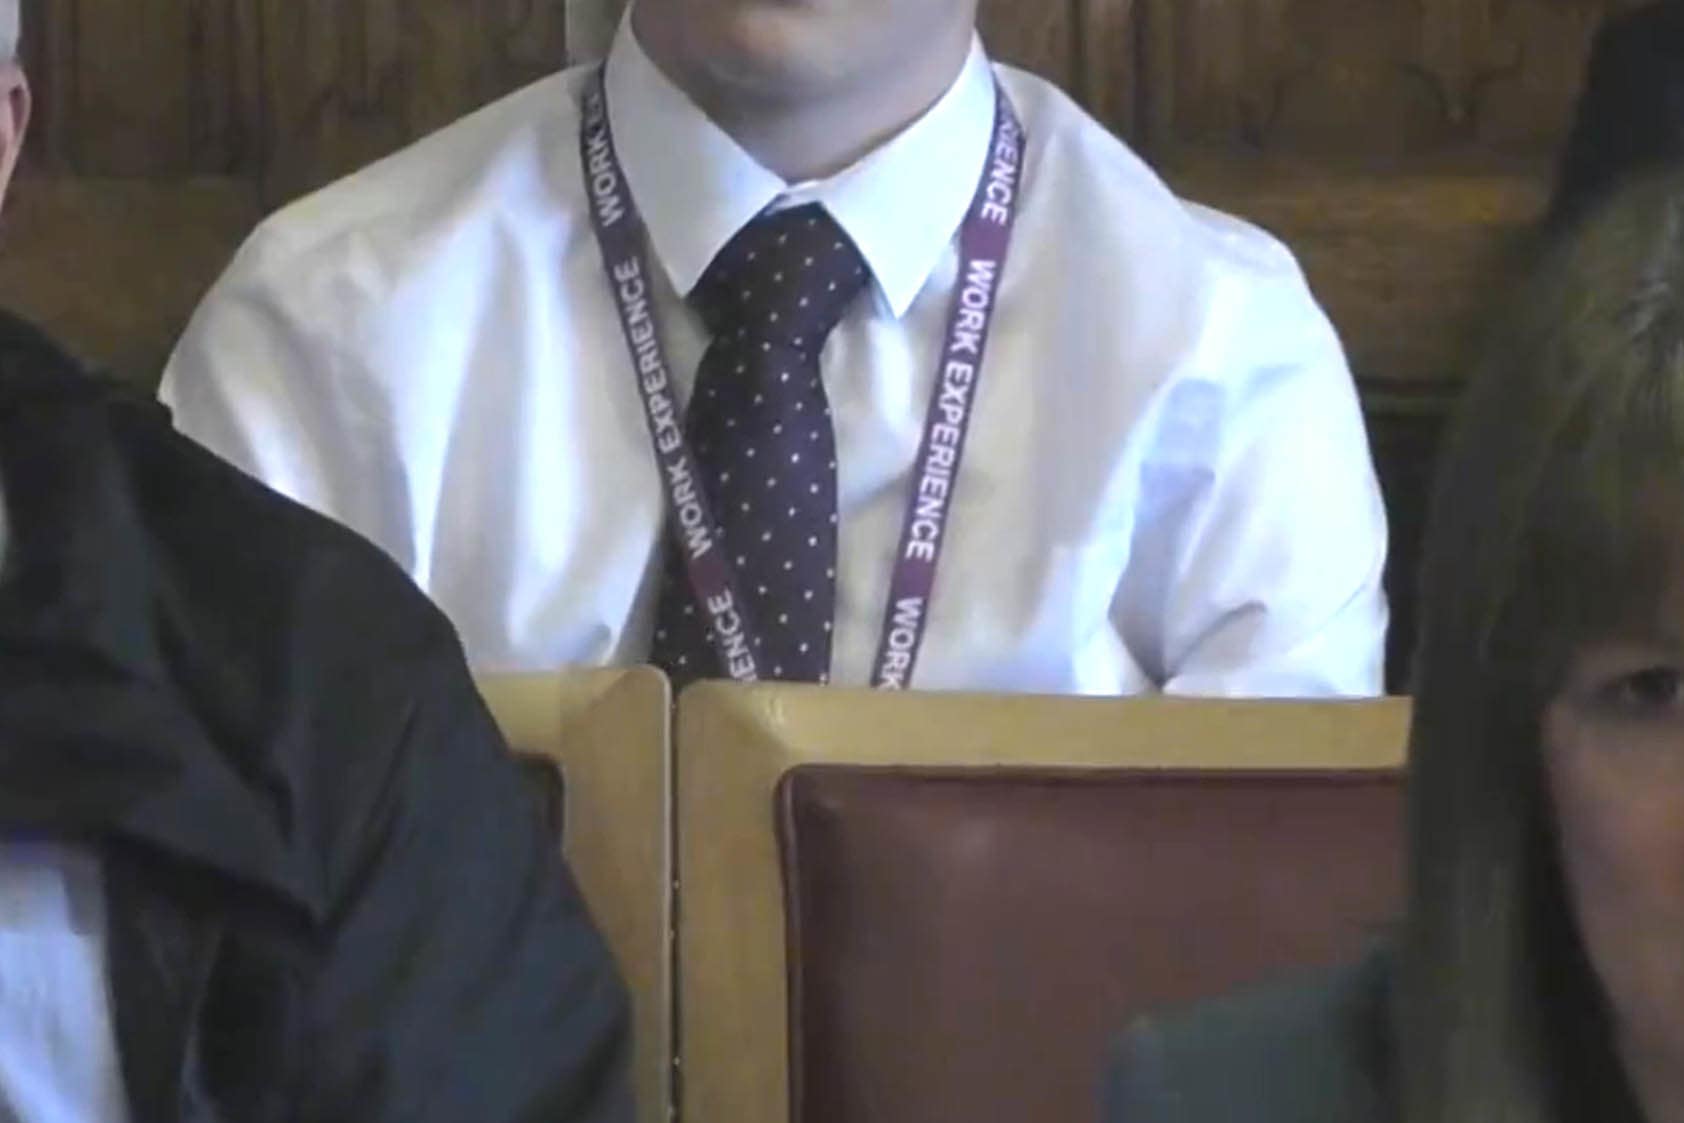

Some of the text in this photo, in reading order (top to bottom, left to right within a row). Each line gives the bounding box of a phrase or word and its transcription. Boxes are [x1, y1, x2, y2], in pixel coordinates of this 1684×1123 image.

[587, 127, 626, 228] WORK
[613, 256, 713, 560] WORK EXPERIENCE
[905, 259, 997, 563] WORK EXPERIENCE
[706, 587, 758, 680] IENCE
[878, 597, 923, 689] WORK
